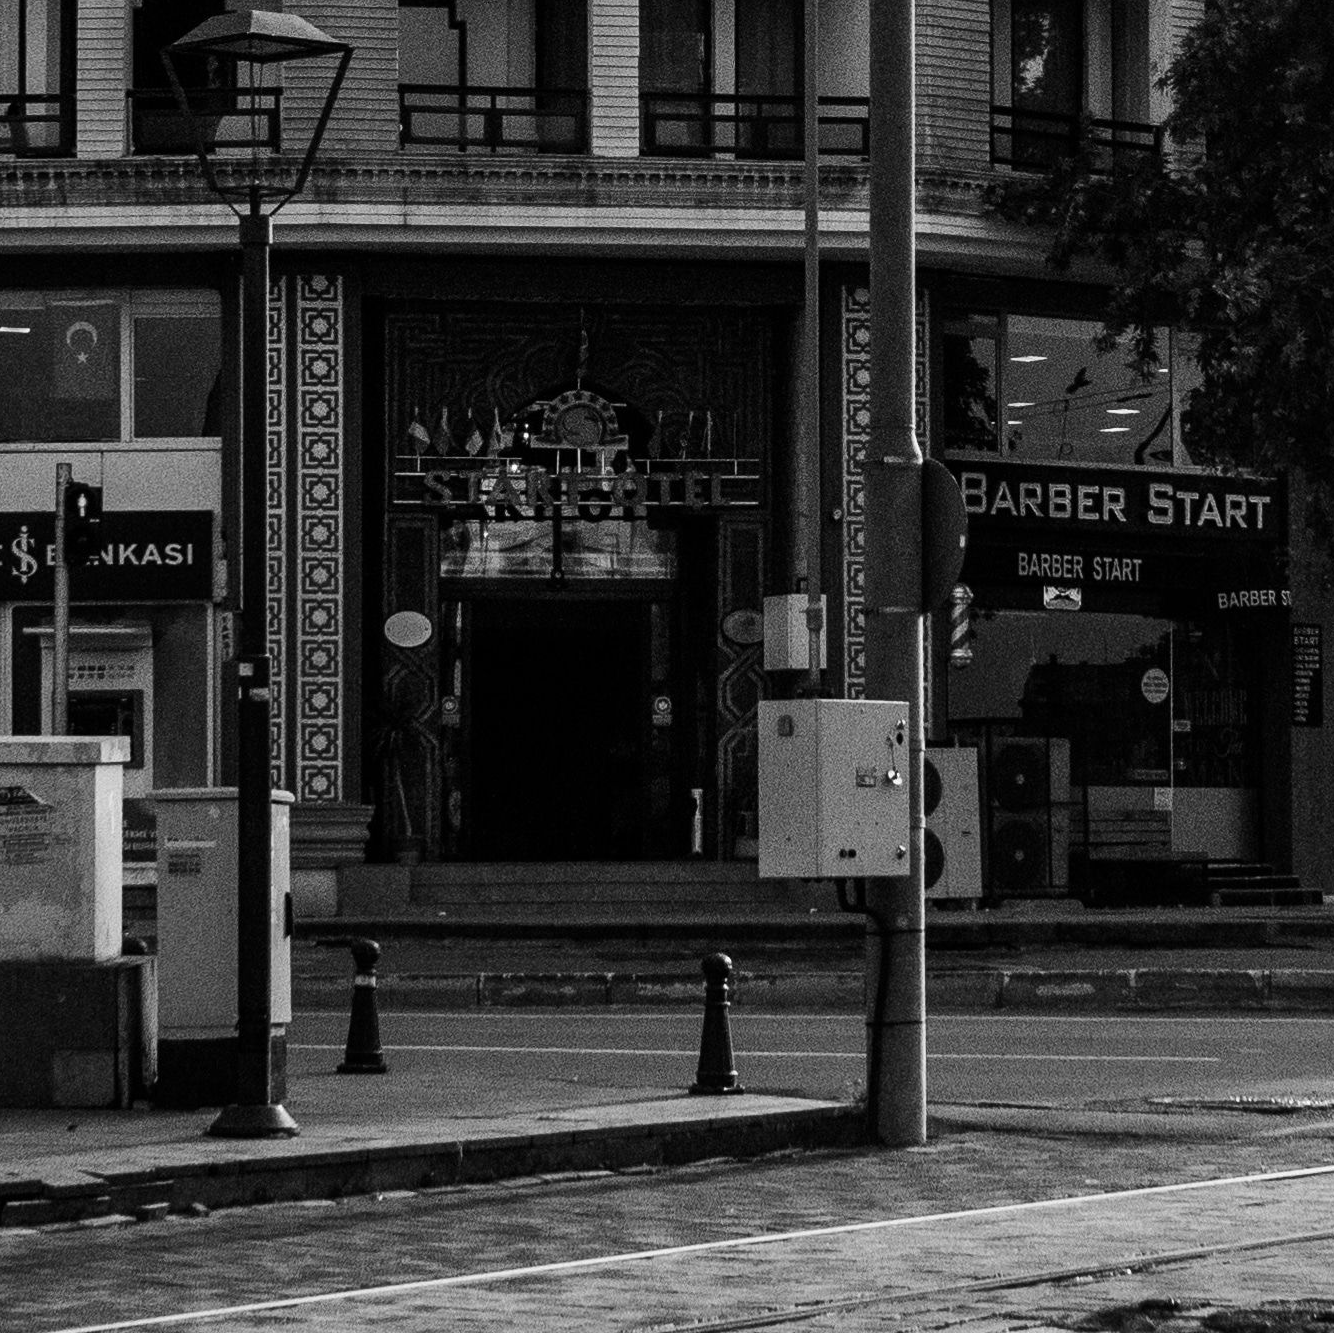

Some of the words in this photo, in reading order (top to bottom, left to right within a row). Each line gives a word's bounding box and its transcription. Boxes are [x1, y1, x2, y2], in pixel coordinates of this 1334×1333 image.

[961, 471, 1127, 523] BARBER
[1148, 482, 1272, 529] START
[45, 541, 195, 567] BNKASI
[1017, 551, 1085, 580] BARBER
[1092, 556, 1144, 584] START
[1217, 589, 1278, 610] BARBER
